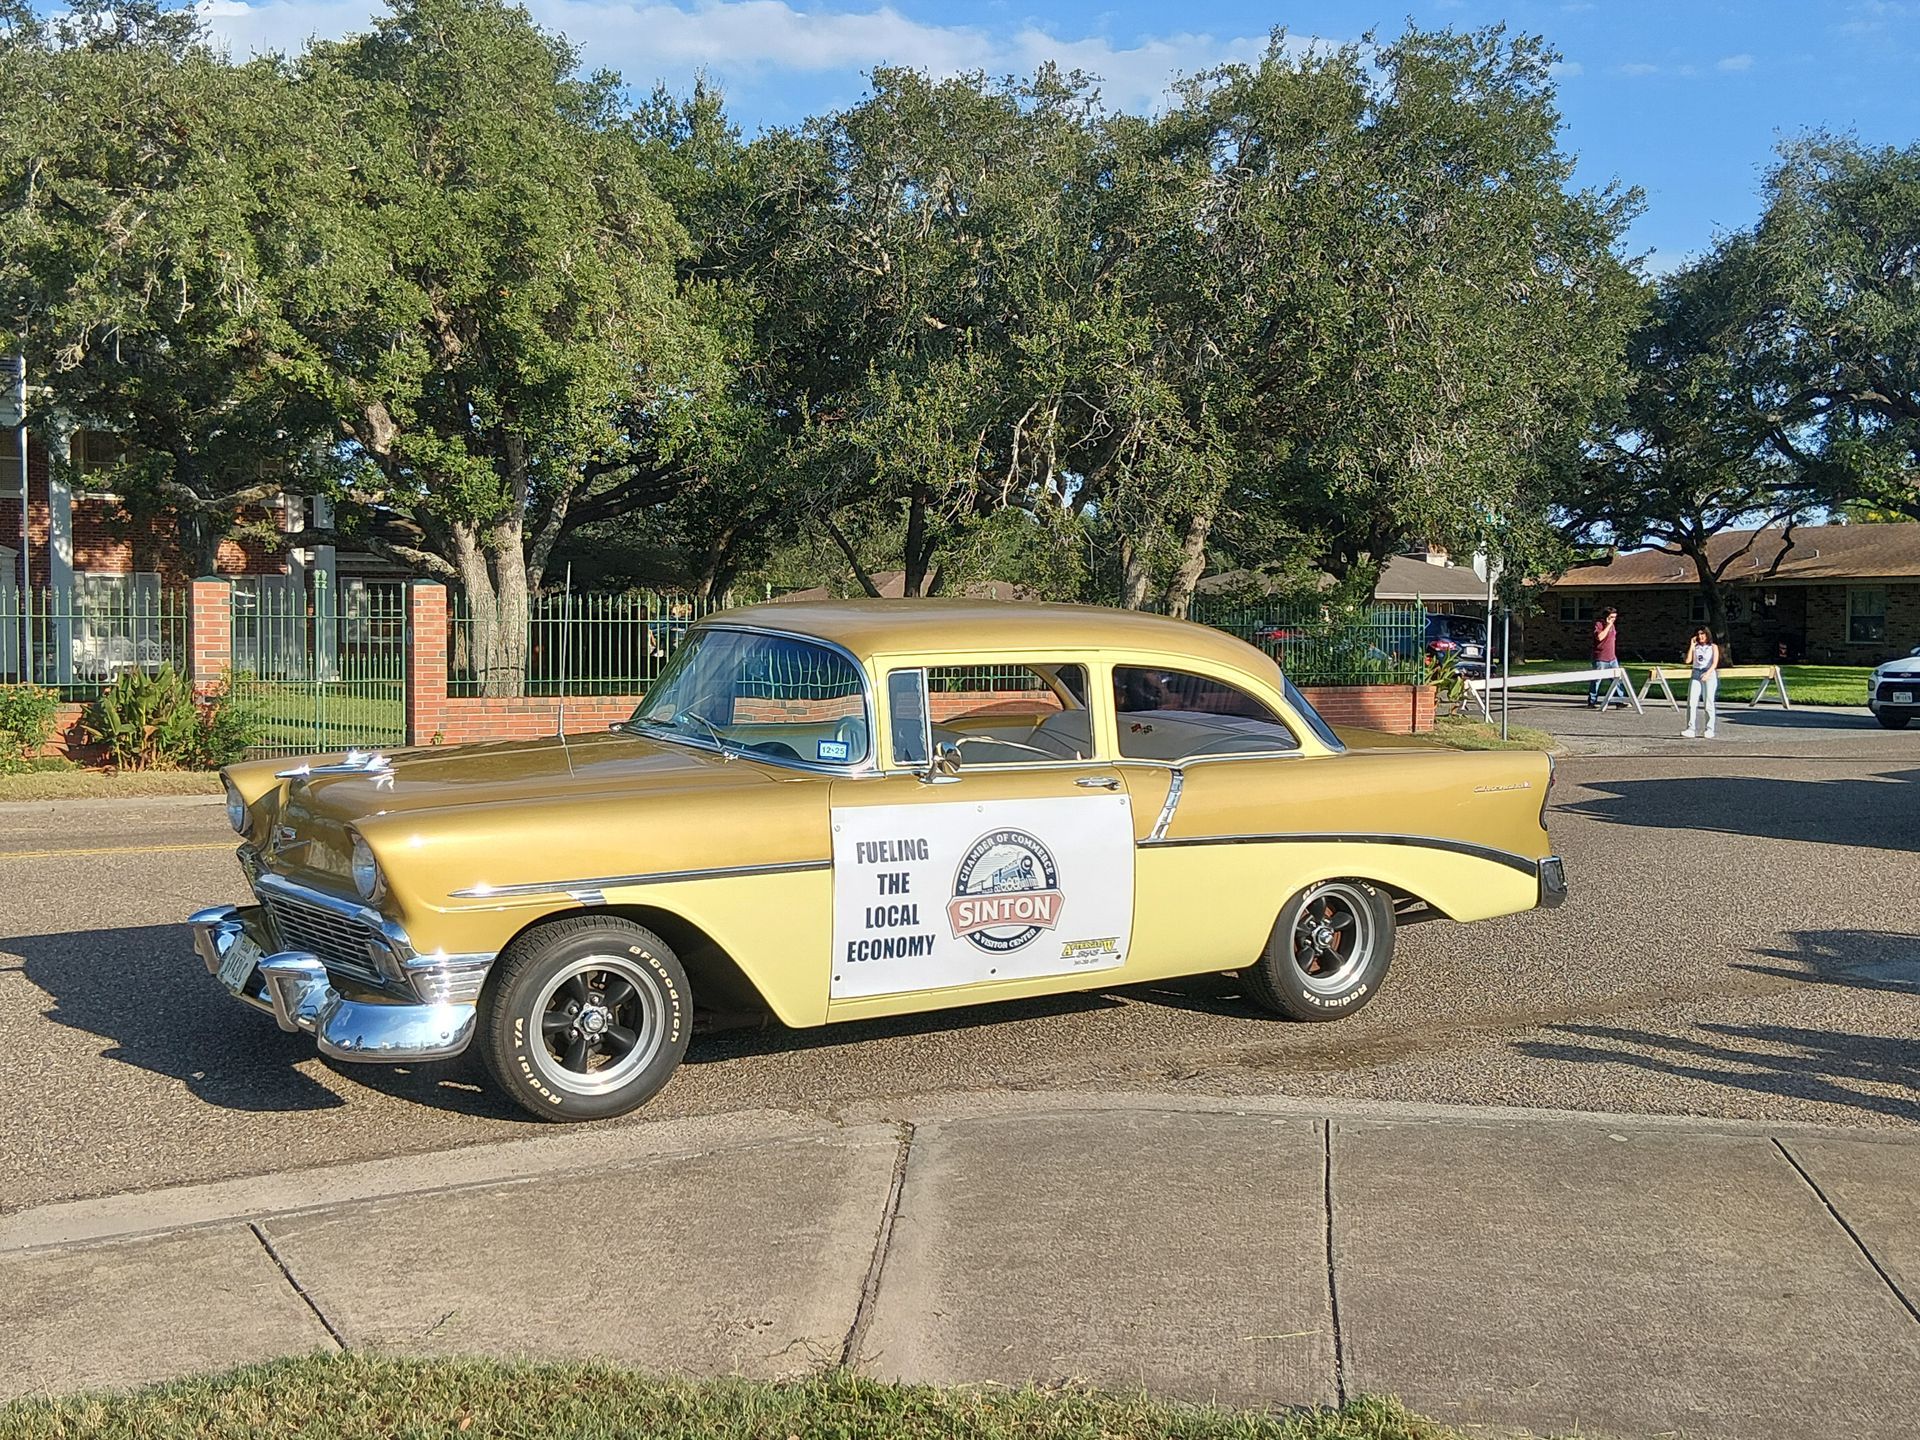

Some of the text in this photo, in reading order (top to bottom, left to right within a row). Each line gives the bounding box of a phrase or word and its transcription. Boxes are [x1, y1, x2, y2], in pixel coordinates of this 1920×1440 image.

[856, 838, 929, 864] FUELING
[960, 833, 1054, 882] CHAMBER OF COMMERCE
[877, 872, 910, 895] THE
[865, 903, 920, 929] LOCAL
[958, 895, 1052, 928] SINTON
[847, 934, 936, 963] ECONOMY
[981, 936, 1008, 949] VISITOR
[1008, 928, 1037, 947] CENTER
[629, 945, 681, 1043] BFGoodrich
[1302, 983, 1368, 1007] Radial T/A
[515, 1017, 563, 1105] Radial T/A
